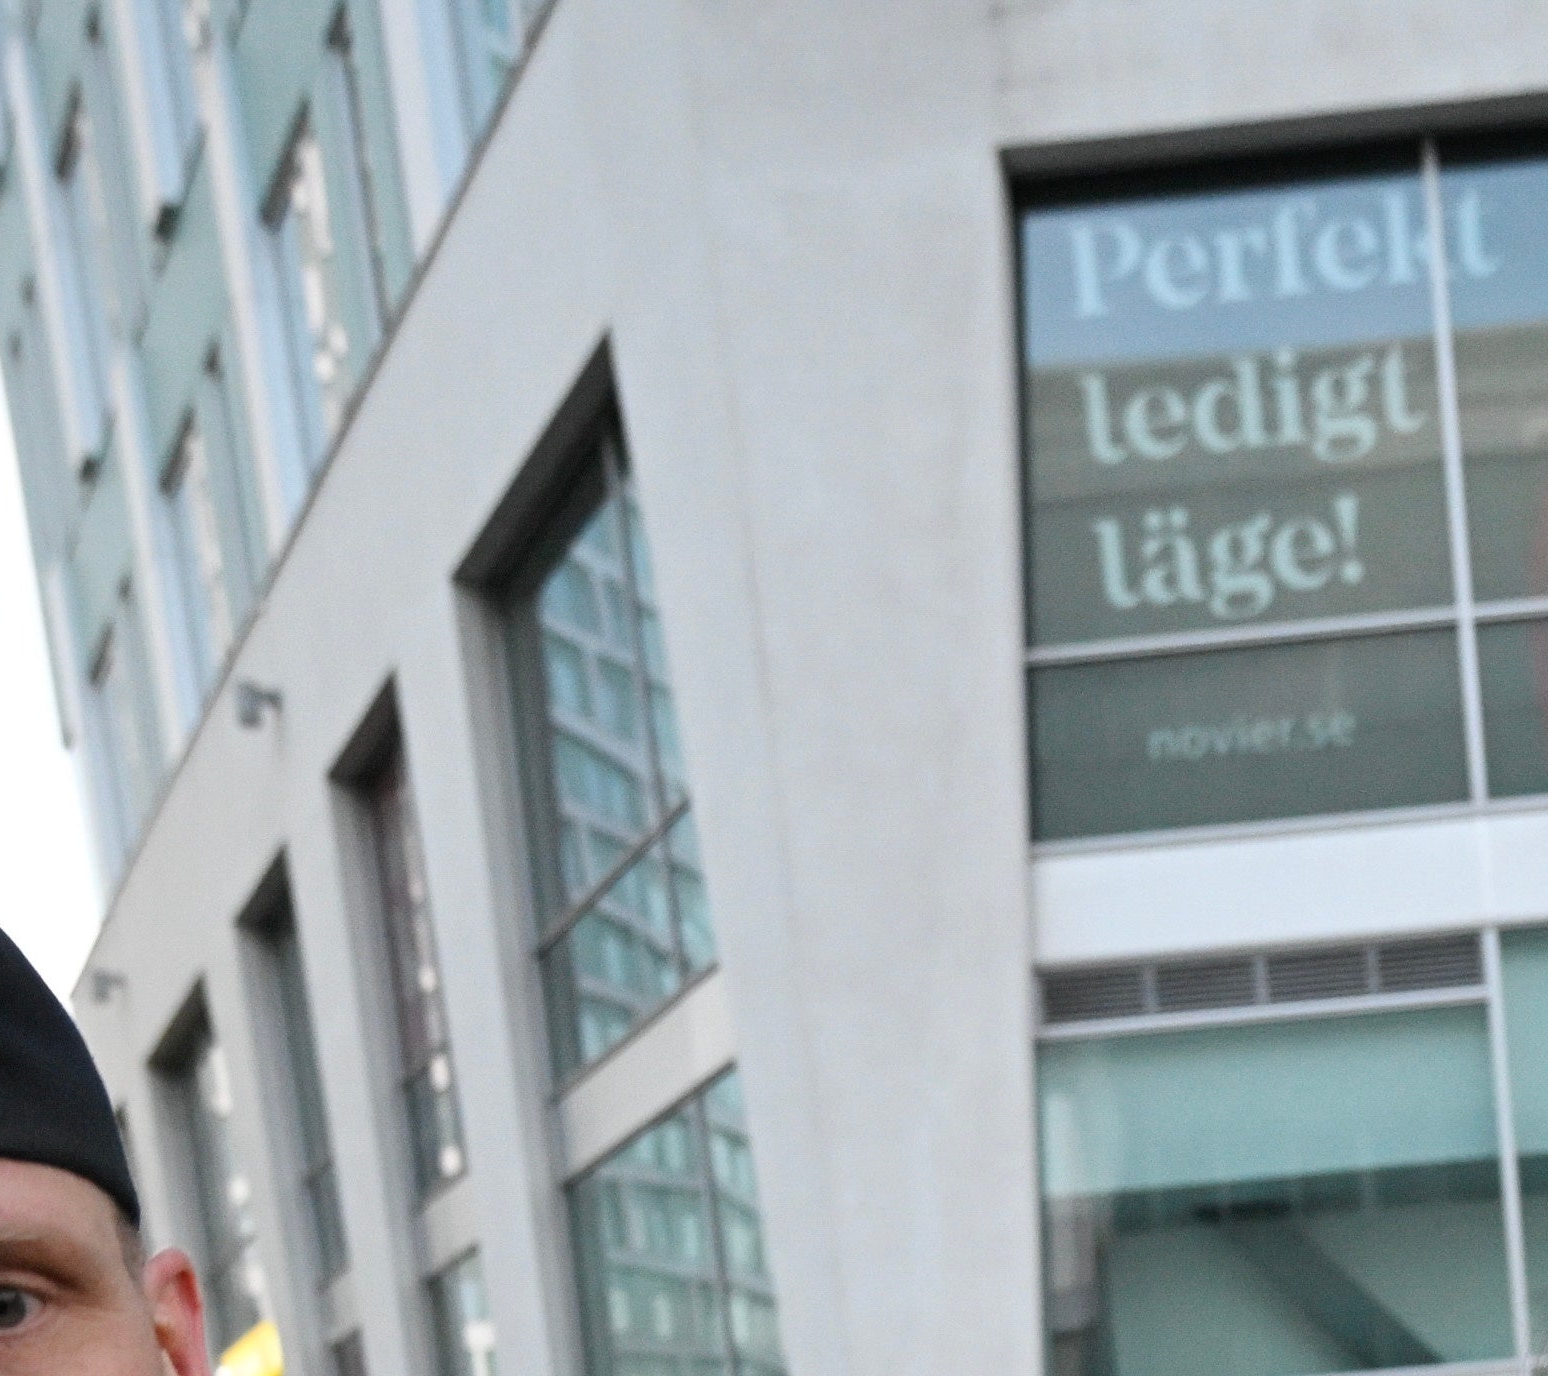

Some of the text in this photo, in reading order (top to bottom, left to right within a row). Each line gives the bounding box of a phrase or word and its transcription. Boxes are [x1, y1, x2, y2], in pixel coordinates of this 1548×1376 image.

[1071, 186, 1500, 320] Perfekt
[1081, 343, 1428, 466] ledigt
[1092, 492, 1366, 619] läge!
[1147, 710, 1355, 760] novier.se
